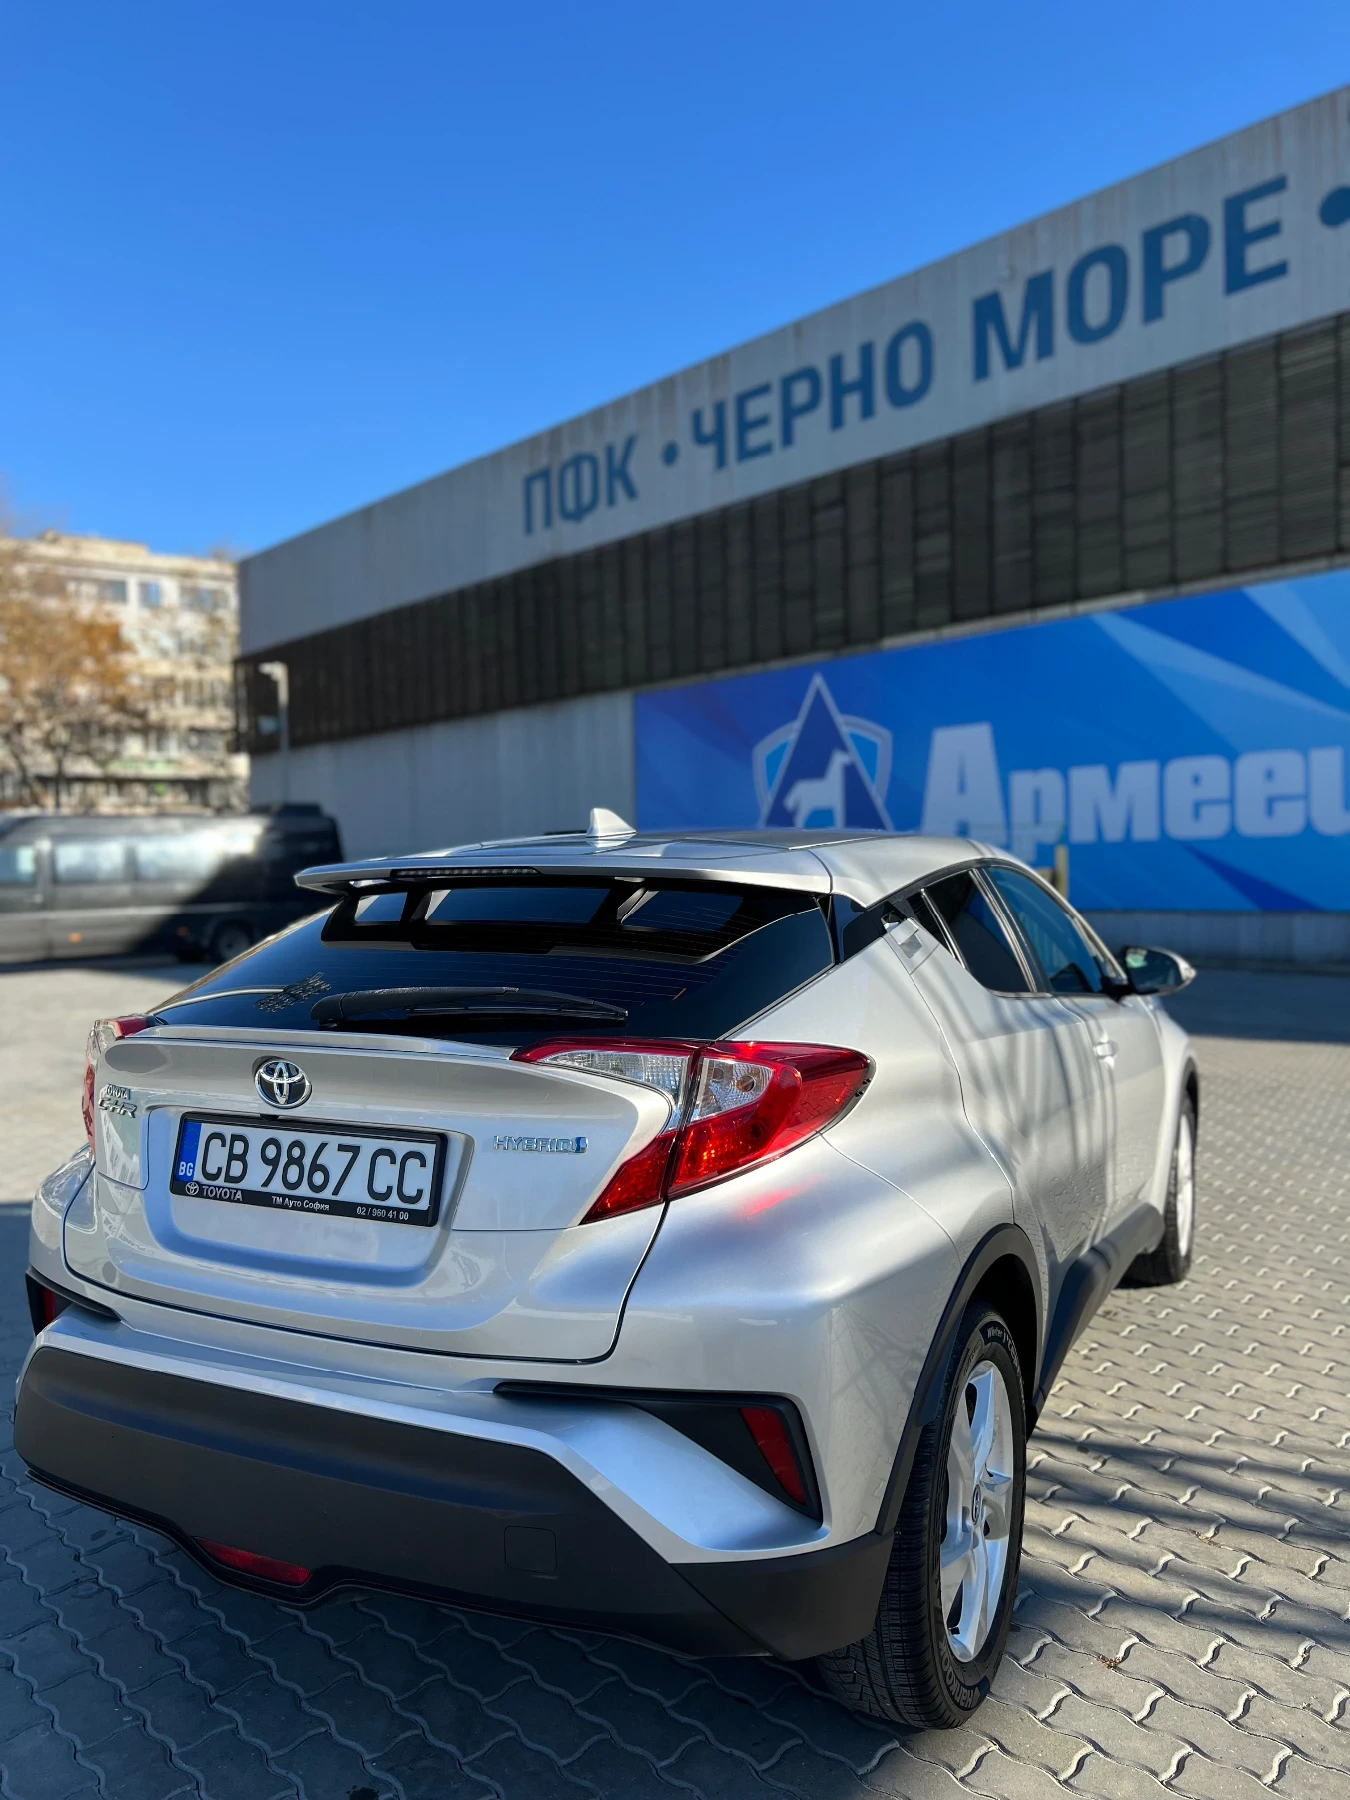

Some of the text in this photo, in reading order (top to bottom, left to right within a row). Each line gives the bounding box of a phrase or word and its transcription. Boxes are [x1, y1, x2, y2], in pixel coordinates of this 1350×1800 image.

[523, 174, 1289, 536] ПФК ЧЕРНО МОРЕ
[103, 1084, 129, 1099] TOYOTA
[493, 1136, 576, 1152] HYBRID
[178, 1161, 194, 1177] BG
[201, 1132, 427, 1204] CB 9867 CC
[202, 1186, 243, 1201] TOYOTA
[283, 1198, 302, 1208] Ауто
[303, 1200, 330, 1211] София
[356, 1206, 366, 1216] 02
[372, 1208, 386, 1218] 960
[387, 1210, 397, 1219] 41
[399, 1211, 409, 1220] 00
